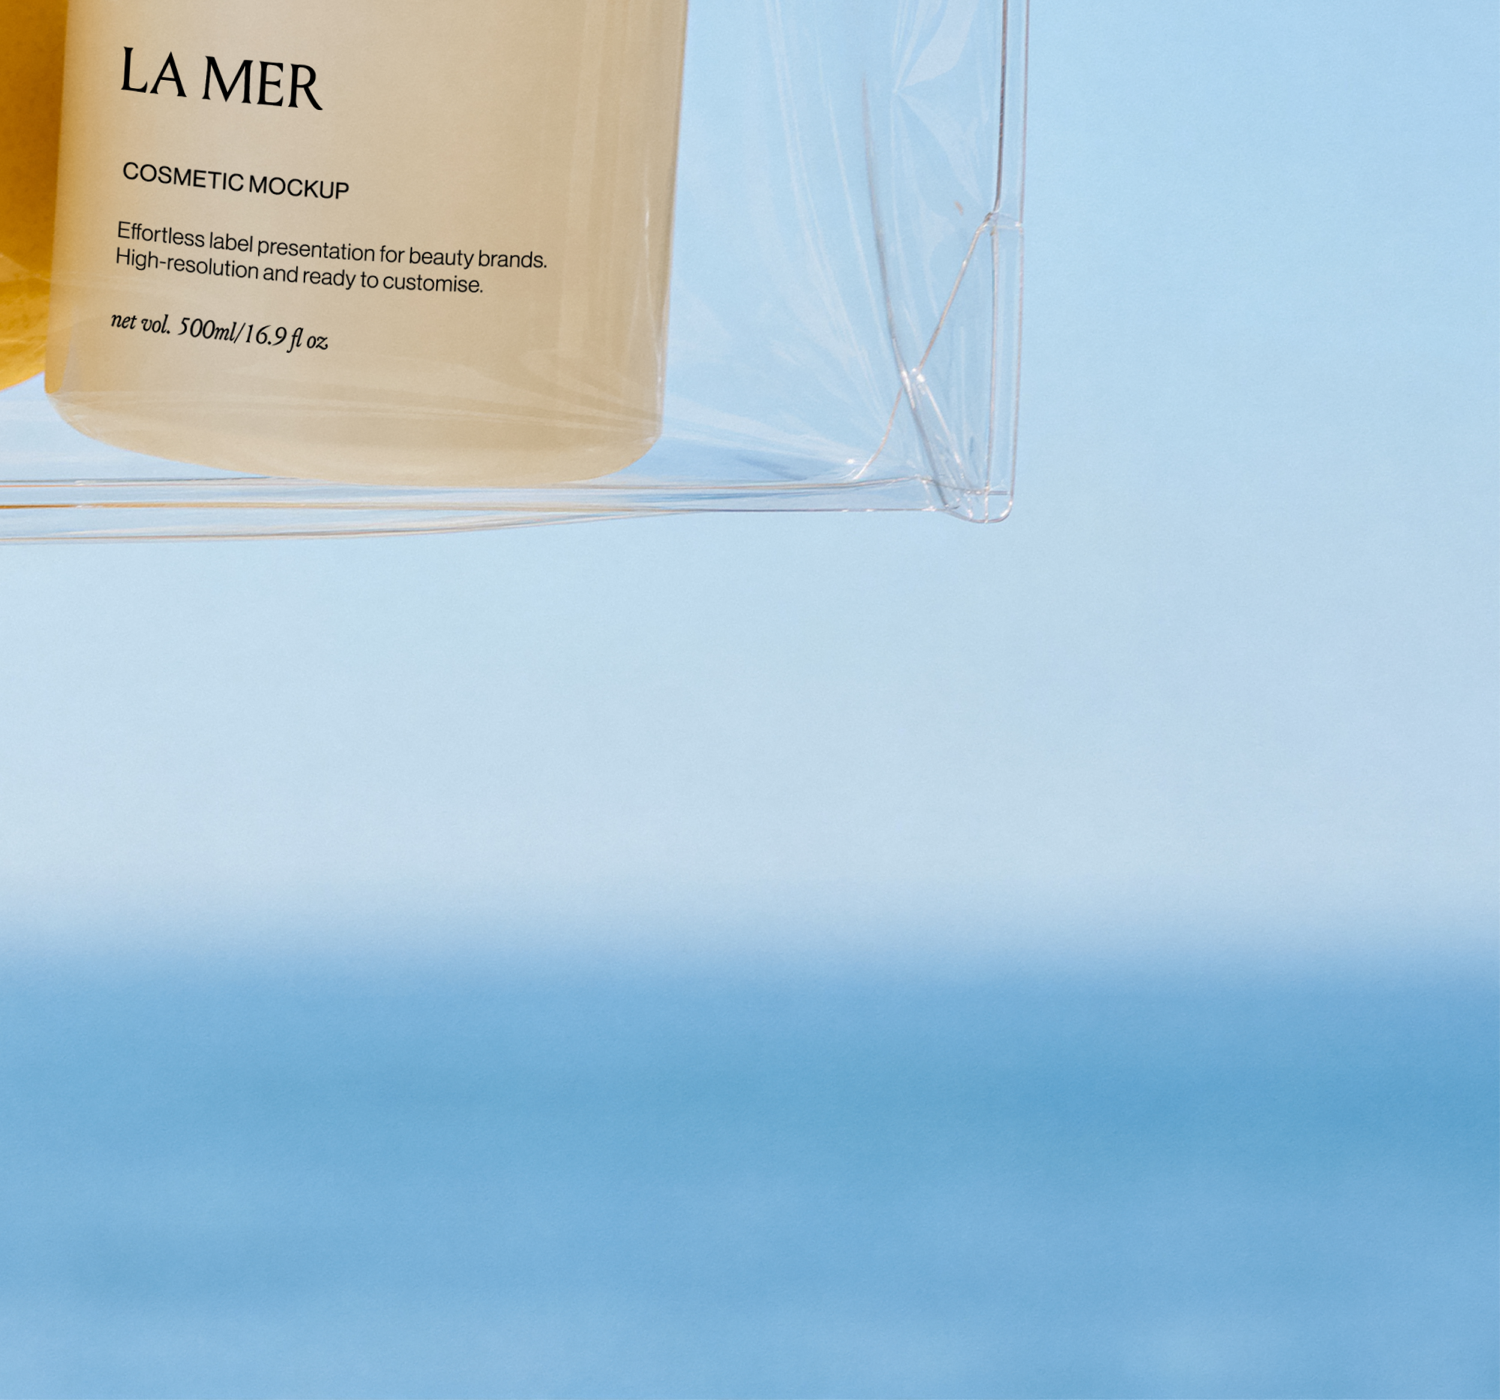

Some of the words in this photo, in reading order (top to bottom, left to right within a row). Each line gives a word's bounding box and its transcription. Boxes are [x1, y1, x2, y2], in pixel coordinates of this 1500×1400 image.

[120, 46, 188, 98] LA
[201, 55, 323, 111] MER
[122, 161, 244, 192] COSMETIC
[248, 174, 350, 200] MOCKUP
[117, 220, 205, 248] Effortless
[209, 231, 254, 253] label
[257, 240, 375, 262] presentation
[379, 244, 406, 264] for
[409, 246, 475, 270] beauty
[478, 249, 547, 269] brands.
[116, 246, 259, 280] High-resolution
[262, 265, 299, 283] and
[302, 268, 357, 291] ready
[360, 271, 379, 289] to
[382, 274, 484, 294] customise.
[110, 313, 138, 330] net
[140, 313, 171, 335] vol.
[177, 316, 288, 346] 500ml/16.9
[286, 326, 304, 354] fl
[306, 335, 329, 351] oz
